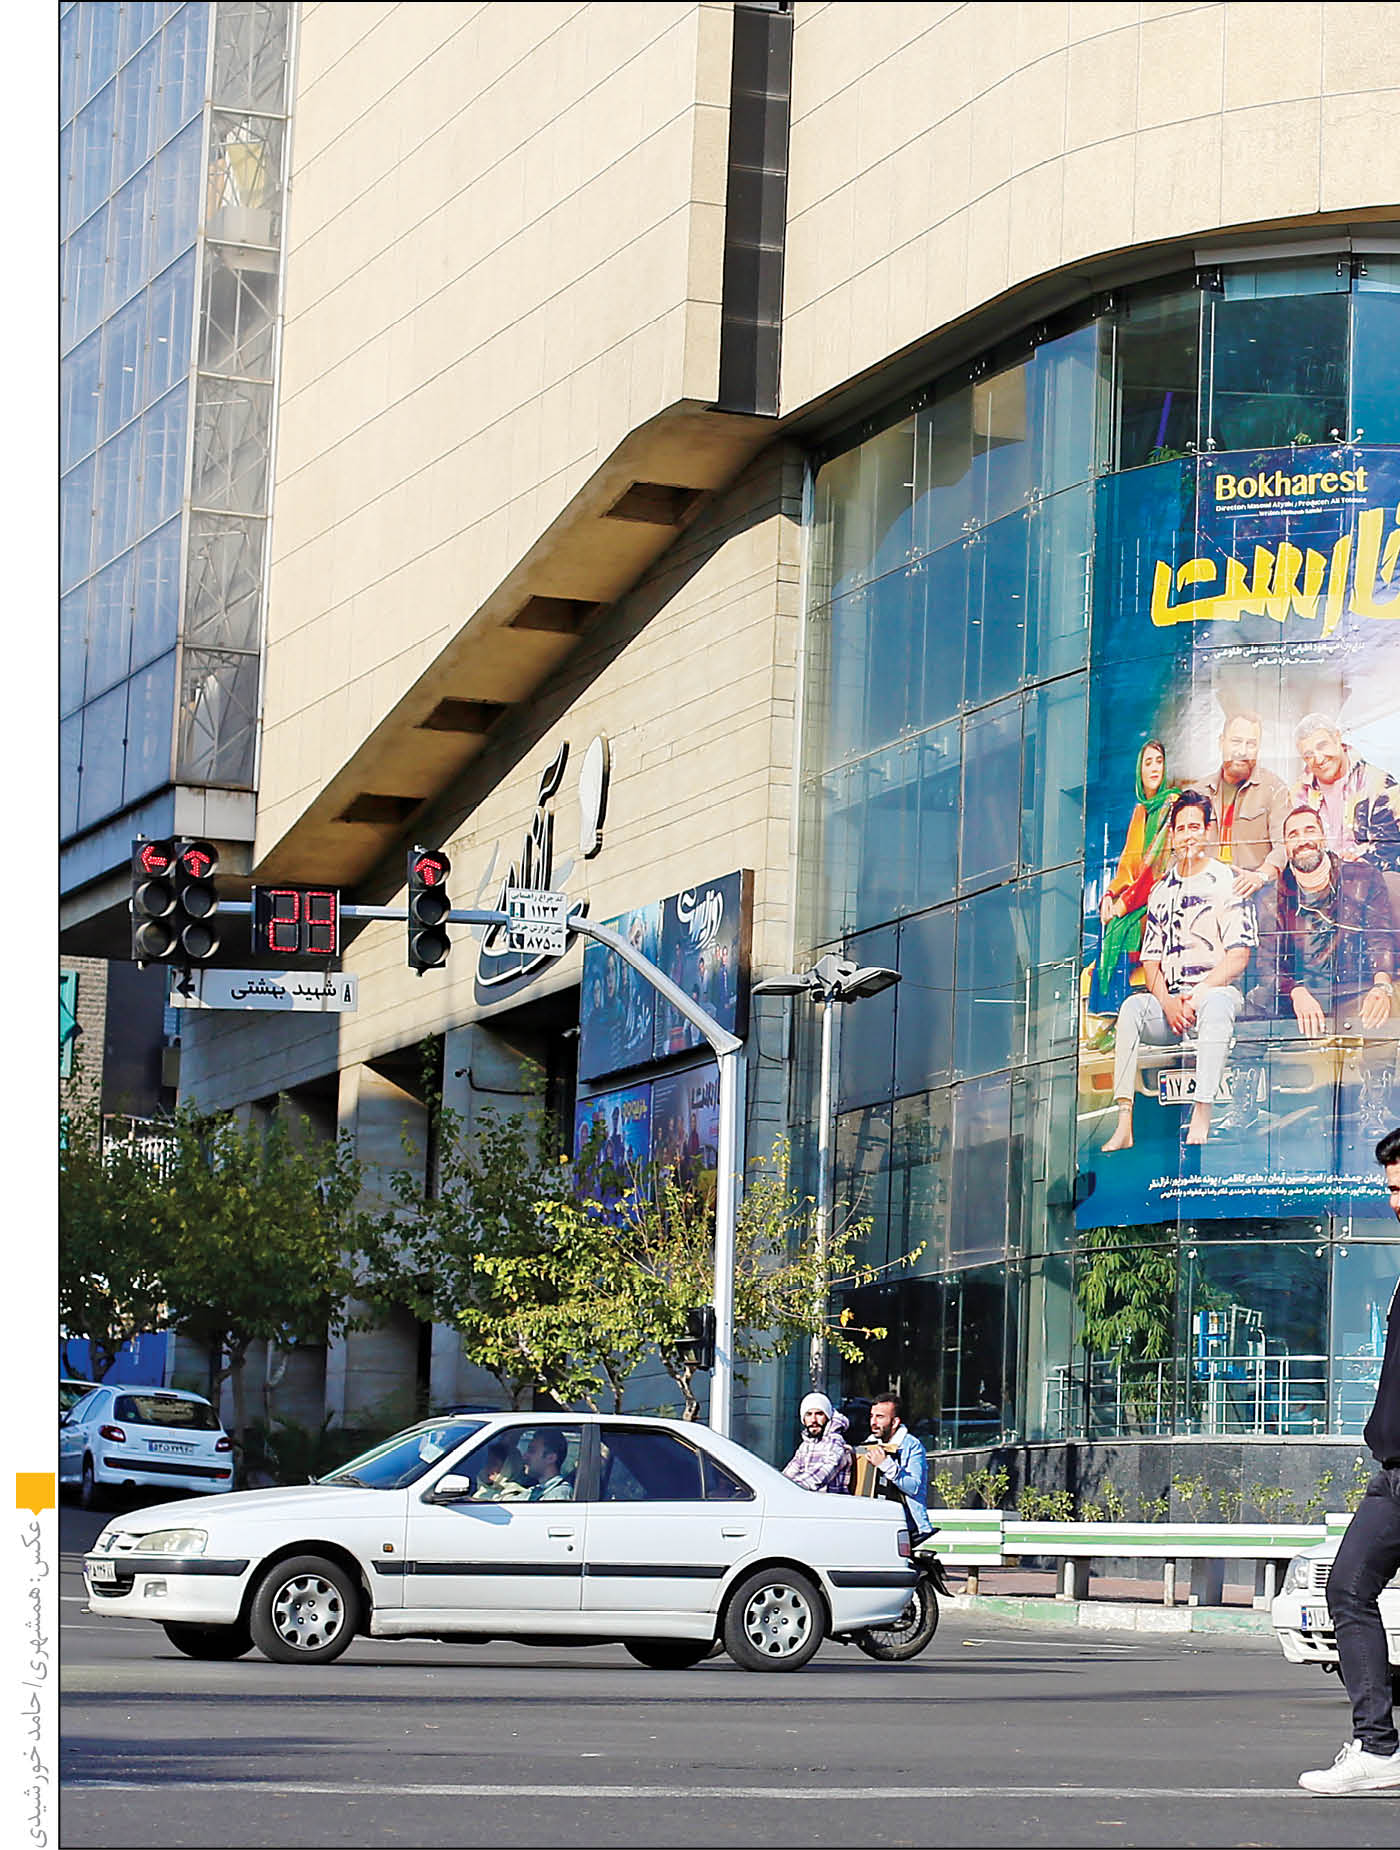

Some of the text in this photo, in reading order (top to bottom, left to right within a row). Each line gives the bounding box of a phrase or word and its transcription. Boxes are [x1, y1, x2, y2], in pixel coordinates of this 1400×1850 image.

[1215, 466, 1369, 501] Bokharest
[268, 889, 337, 953] 29
[531, 904, 559, 918] ۱۱۳۳
[526, 936, 563, 950] ۸۷۵۰۰
[230, 977, 338, 1002] شهید بهشتی
